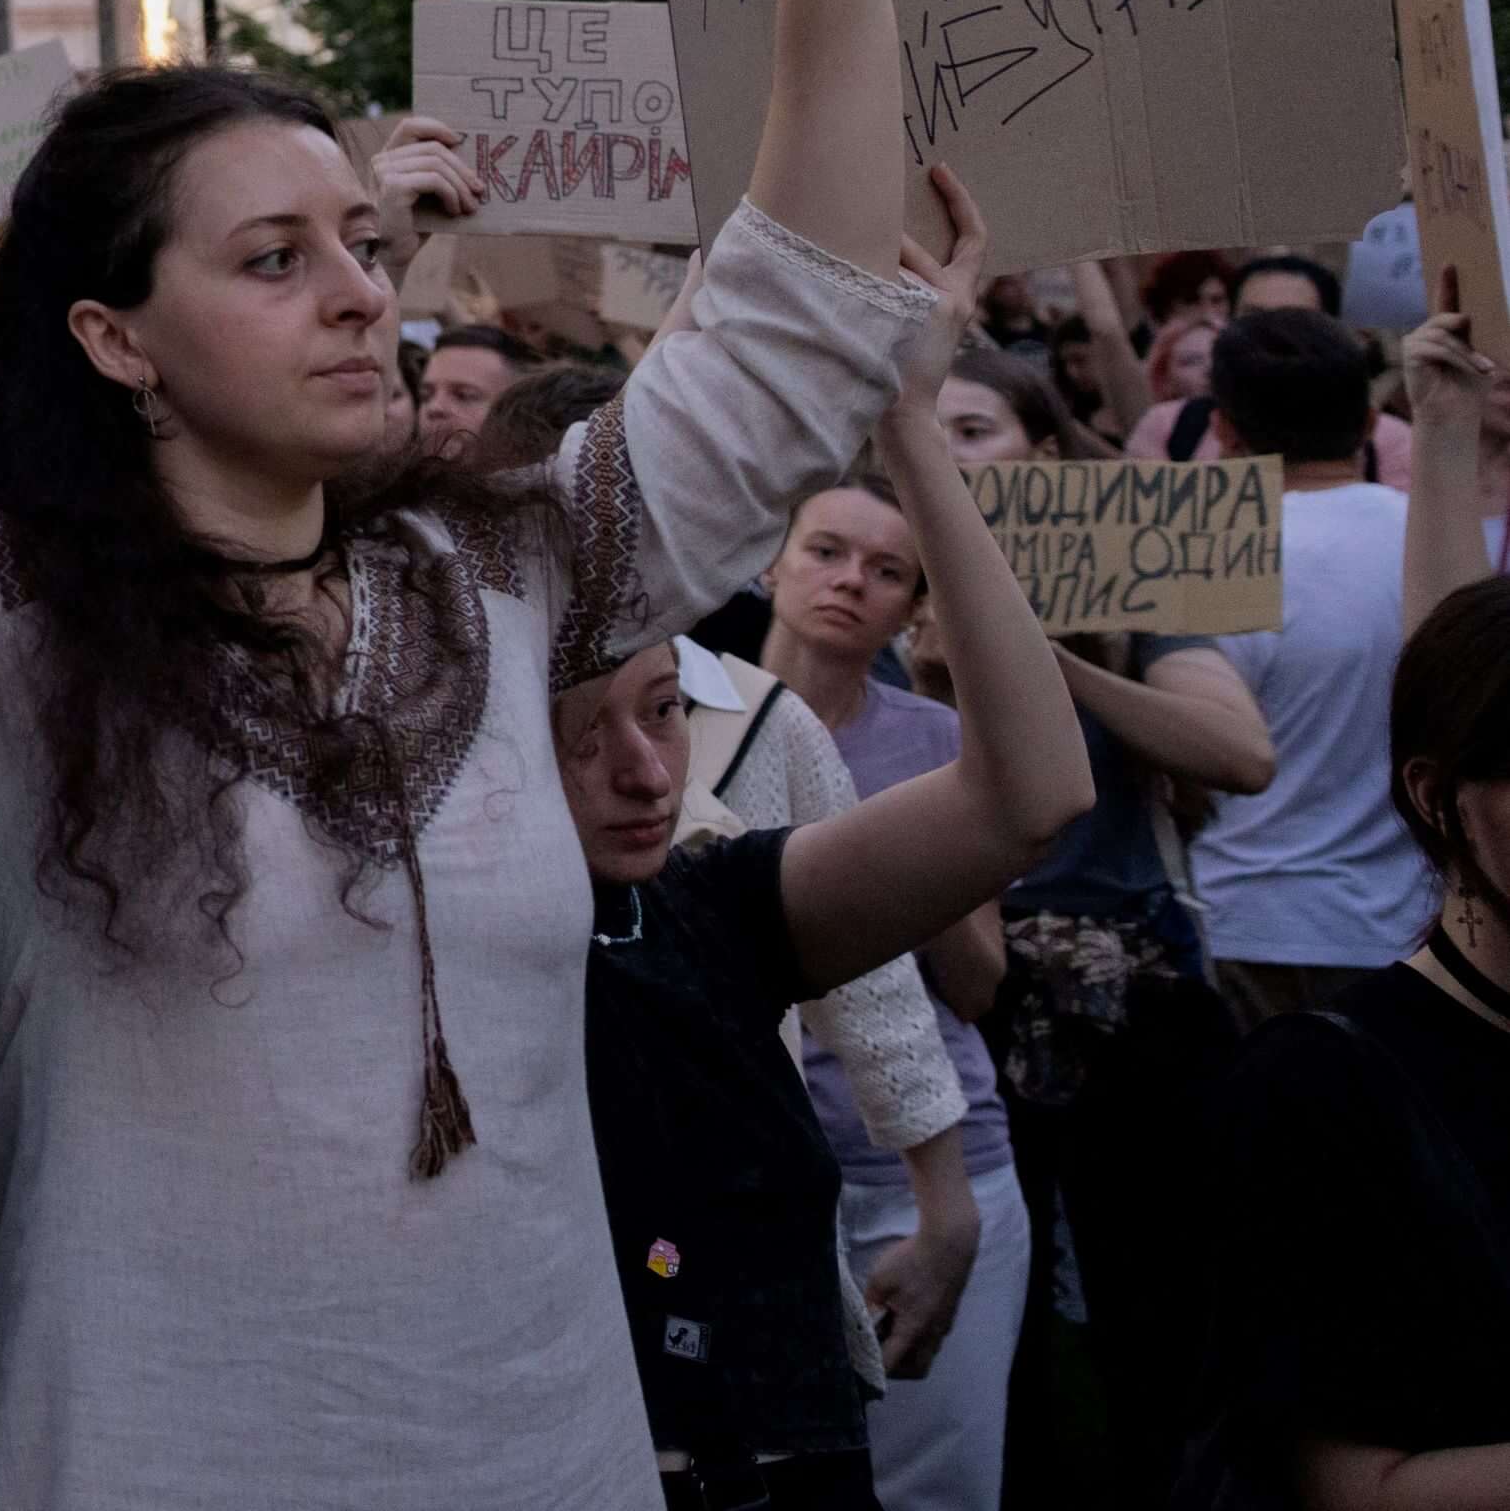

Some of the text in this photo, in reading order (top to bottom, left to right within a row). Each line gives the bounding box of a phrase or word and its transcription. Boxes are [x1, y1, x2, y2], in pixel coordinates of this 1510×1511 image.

[492, 7, 611, 74] ЦЕ
[471, 77, 675, 125] ТУПО
[1130, 525, 1284, 580] ОДИН
